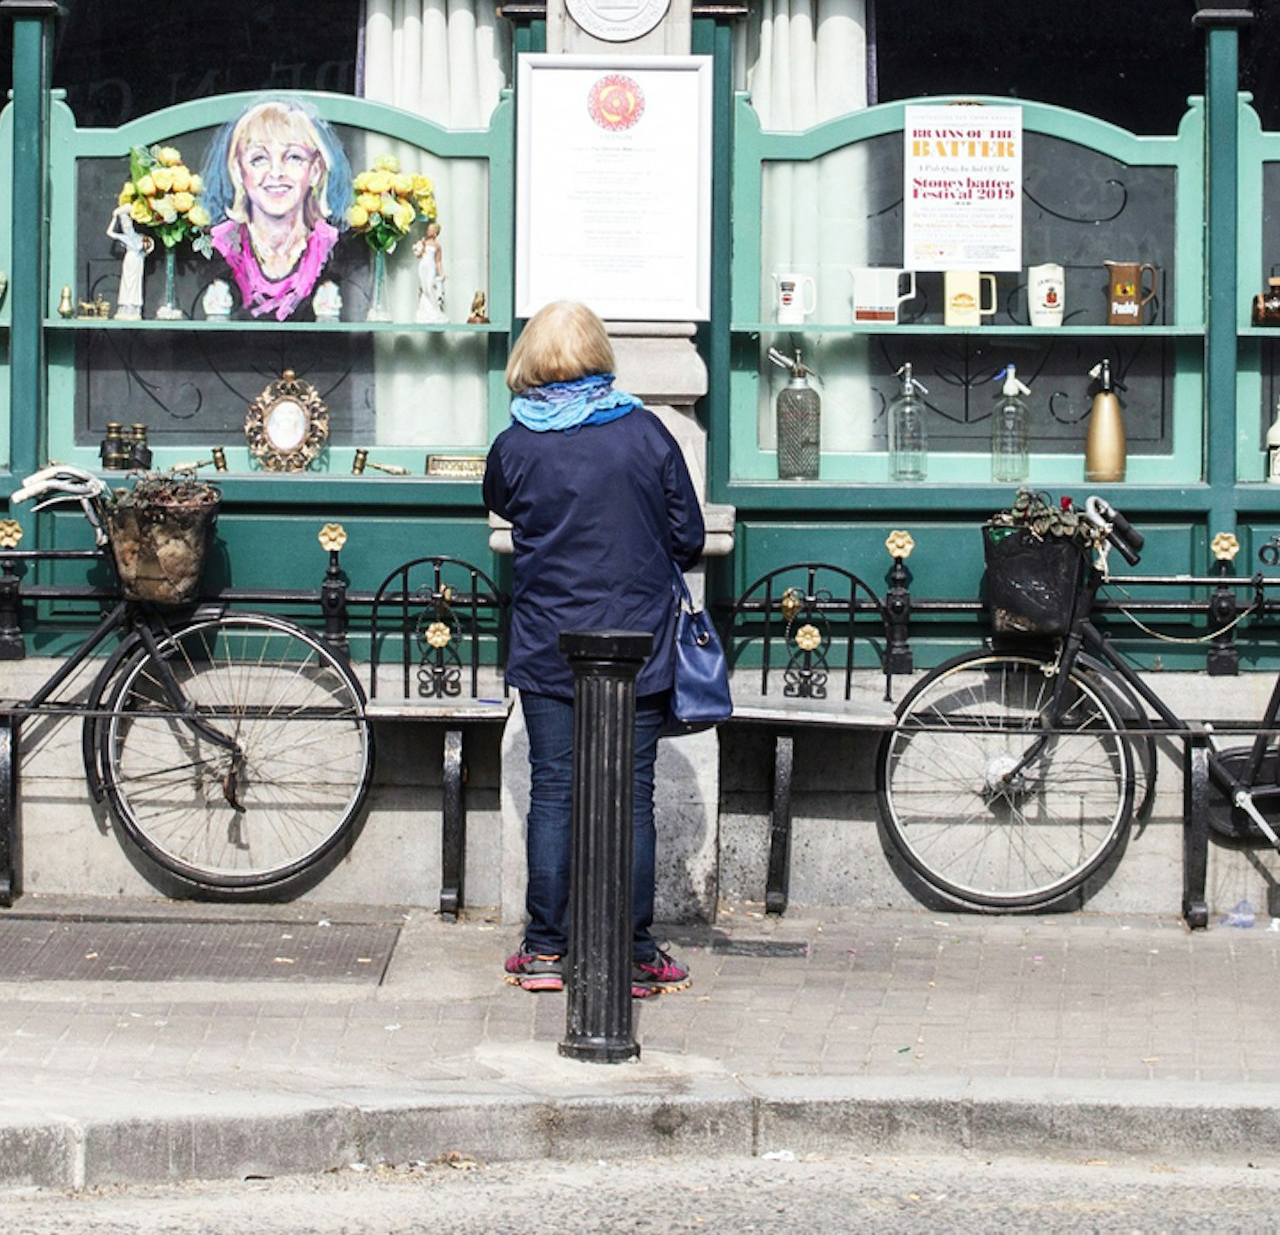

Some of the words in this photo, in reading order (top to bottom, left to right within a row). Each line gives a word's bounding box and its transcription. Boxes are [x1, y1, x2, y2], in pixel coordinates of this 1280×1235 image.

[912, 129, 964, 139] BRAINS
[912, 140, 1015, 158] BATTER
[912, 176, 1015, 191] Stoneybatter
[912, 187, 973, 200] Festival
[977, 187, 1016, 200] 2019
[1111, 301, 1139, 317] Paddy
